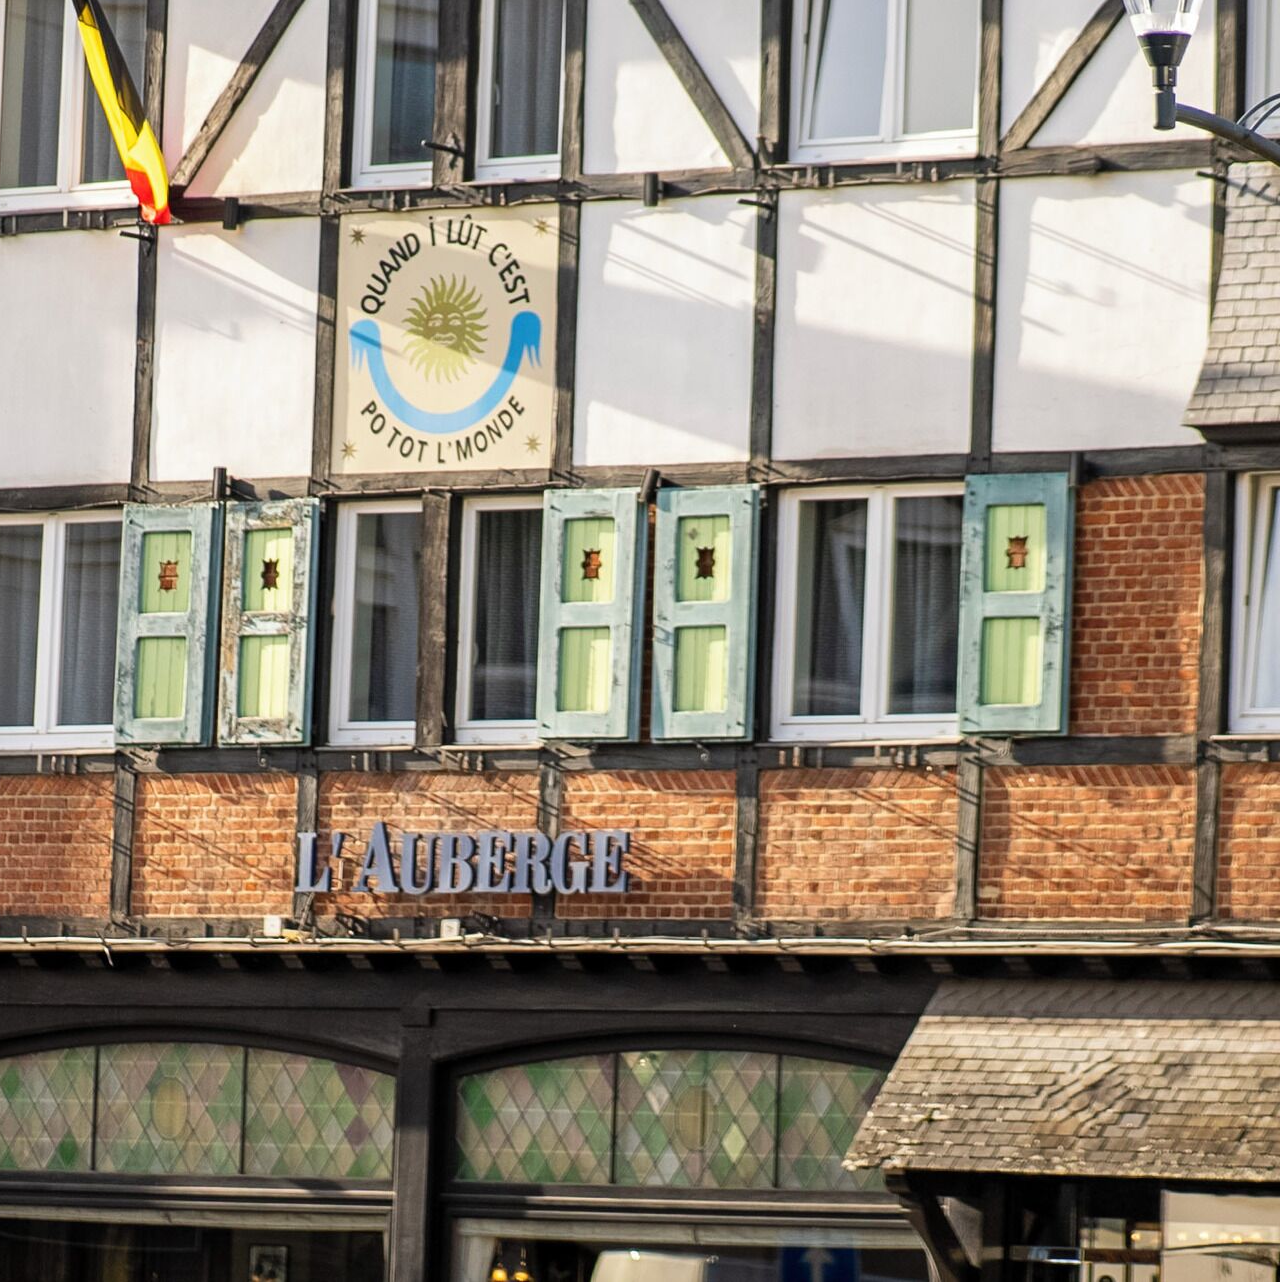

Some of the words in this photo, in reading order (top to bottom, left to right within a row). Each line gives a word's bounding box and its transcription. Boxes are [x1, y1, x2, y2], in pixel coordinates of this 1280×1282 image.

[361, 233, 421, 315] QUAND
[447, 214, 488, 250] LÛT
[488, 243, 531, 305] C'EST
[360, 400, 386, 435] PO
[386, 426, 428, 463] TOT
[437, 395, 526, 464] L'MONDE
